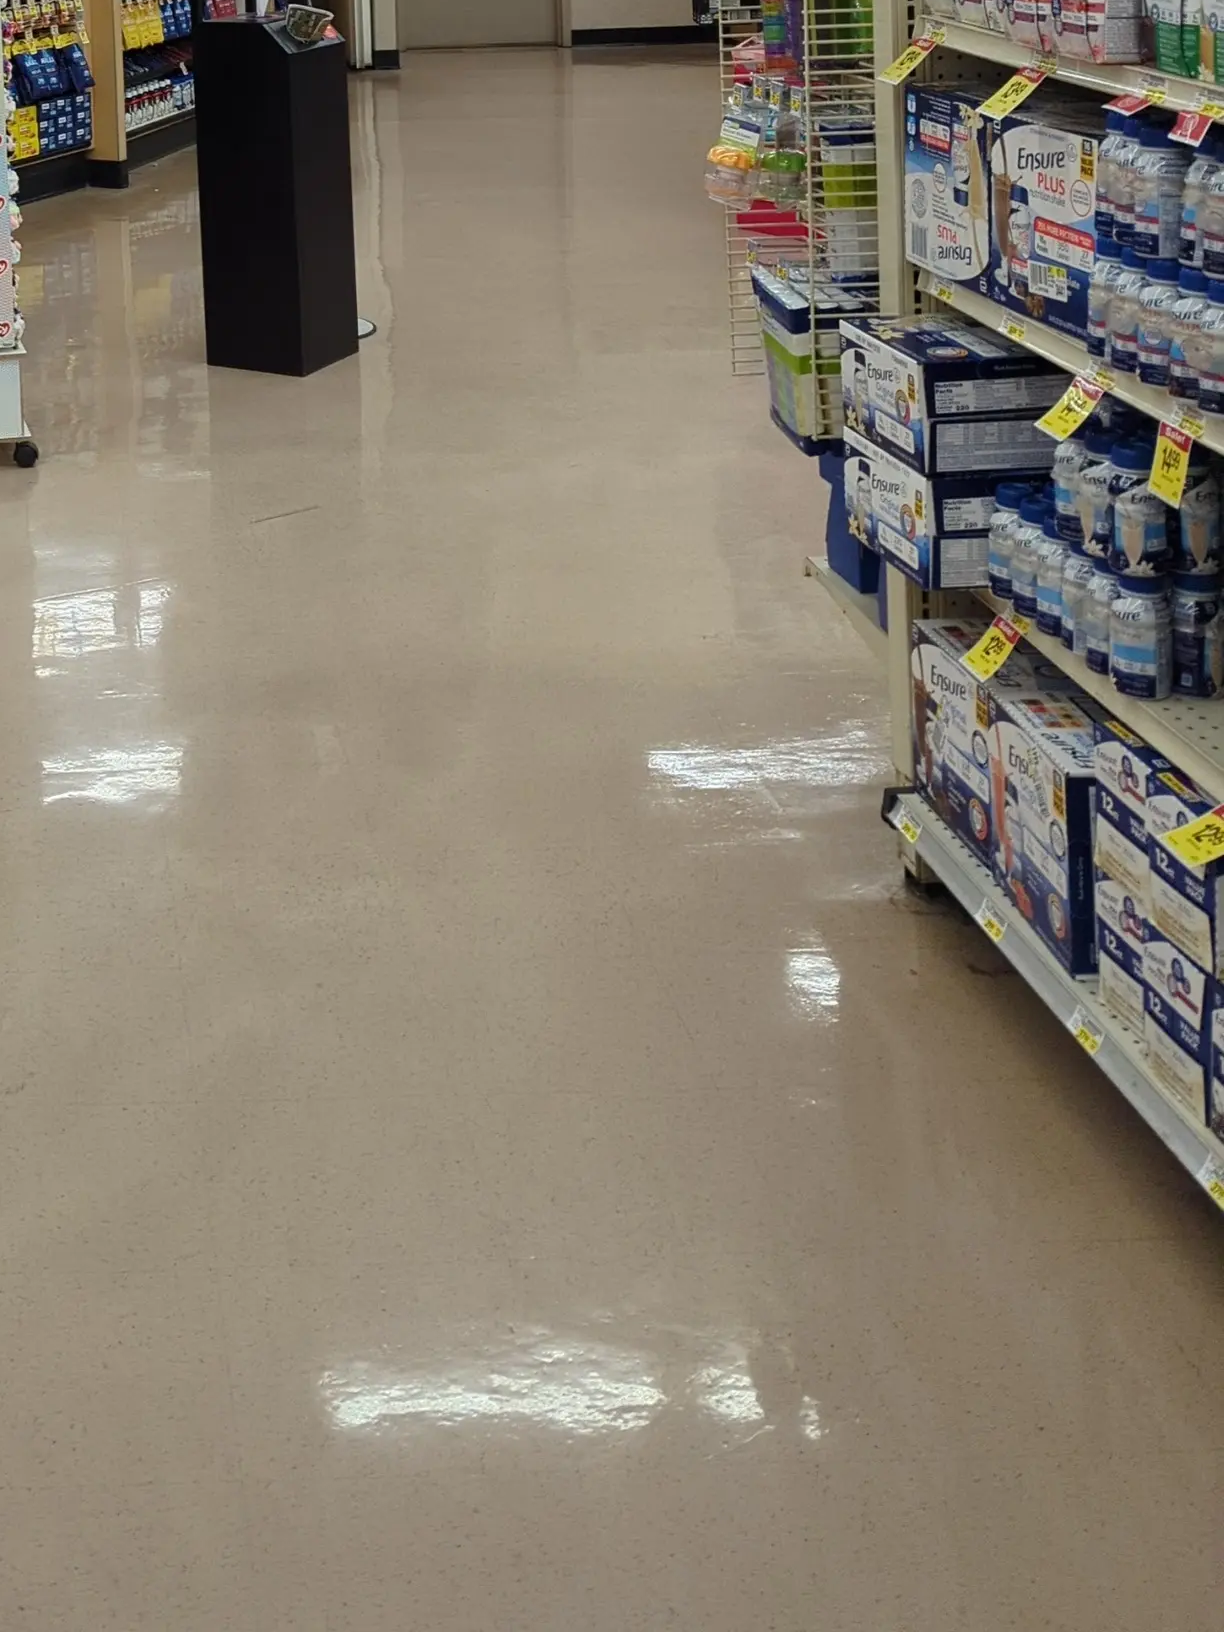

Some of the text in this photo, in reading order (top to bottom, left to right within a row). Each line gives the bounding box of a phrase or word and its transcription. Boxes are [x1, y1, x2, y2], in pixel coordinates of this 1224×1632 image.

[1018, 147, 1066, 172] Ensure
[1037, 171, 1066, 196] PLUS
[937, 224, 960, 244] PLUS
[938, 245, 972, 266] Ensure
[868, 362, 894, 383] Ensure
[872, 474, 900, 495] Ensure
[930, 664, 967, 701] Ensure
